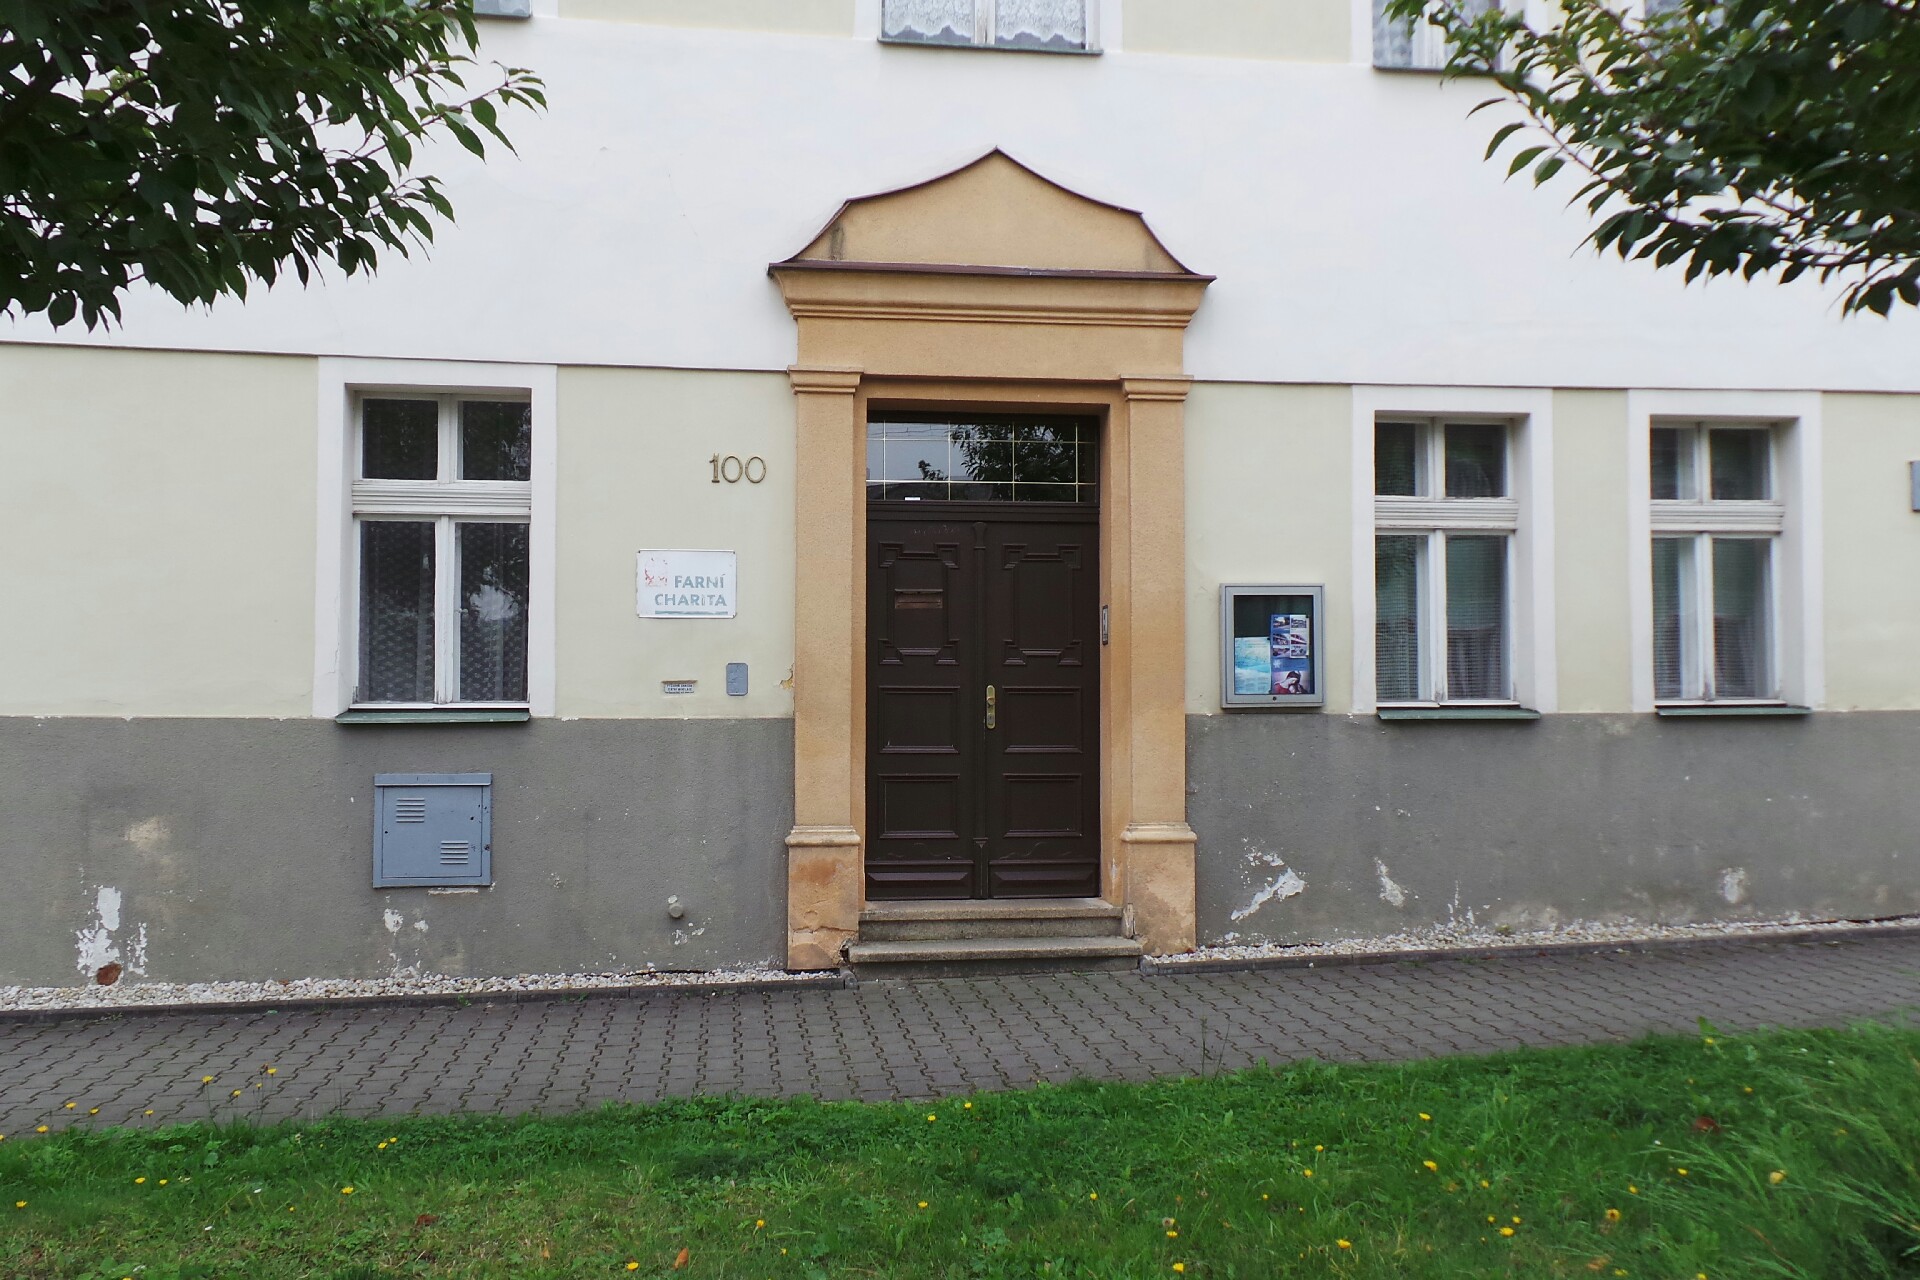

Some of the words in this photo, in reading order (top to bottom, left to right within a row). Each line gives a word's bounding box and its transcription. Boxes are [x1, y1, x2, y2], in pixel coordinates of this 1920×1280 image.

[709, 453, 767, 483] 100
[674, 574, 726, 589] FARNÍ
[654, 593, 728, 606] CHARITA
